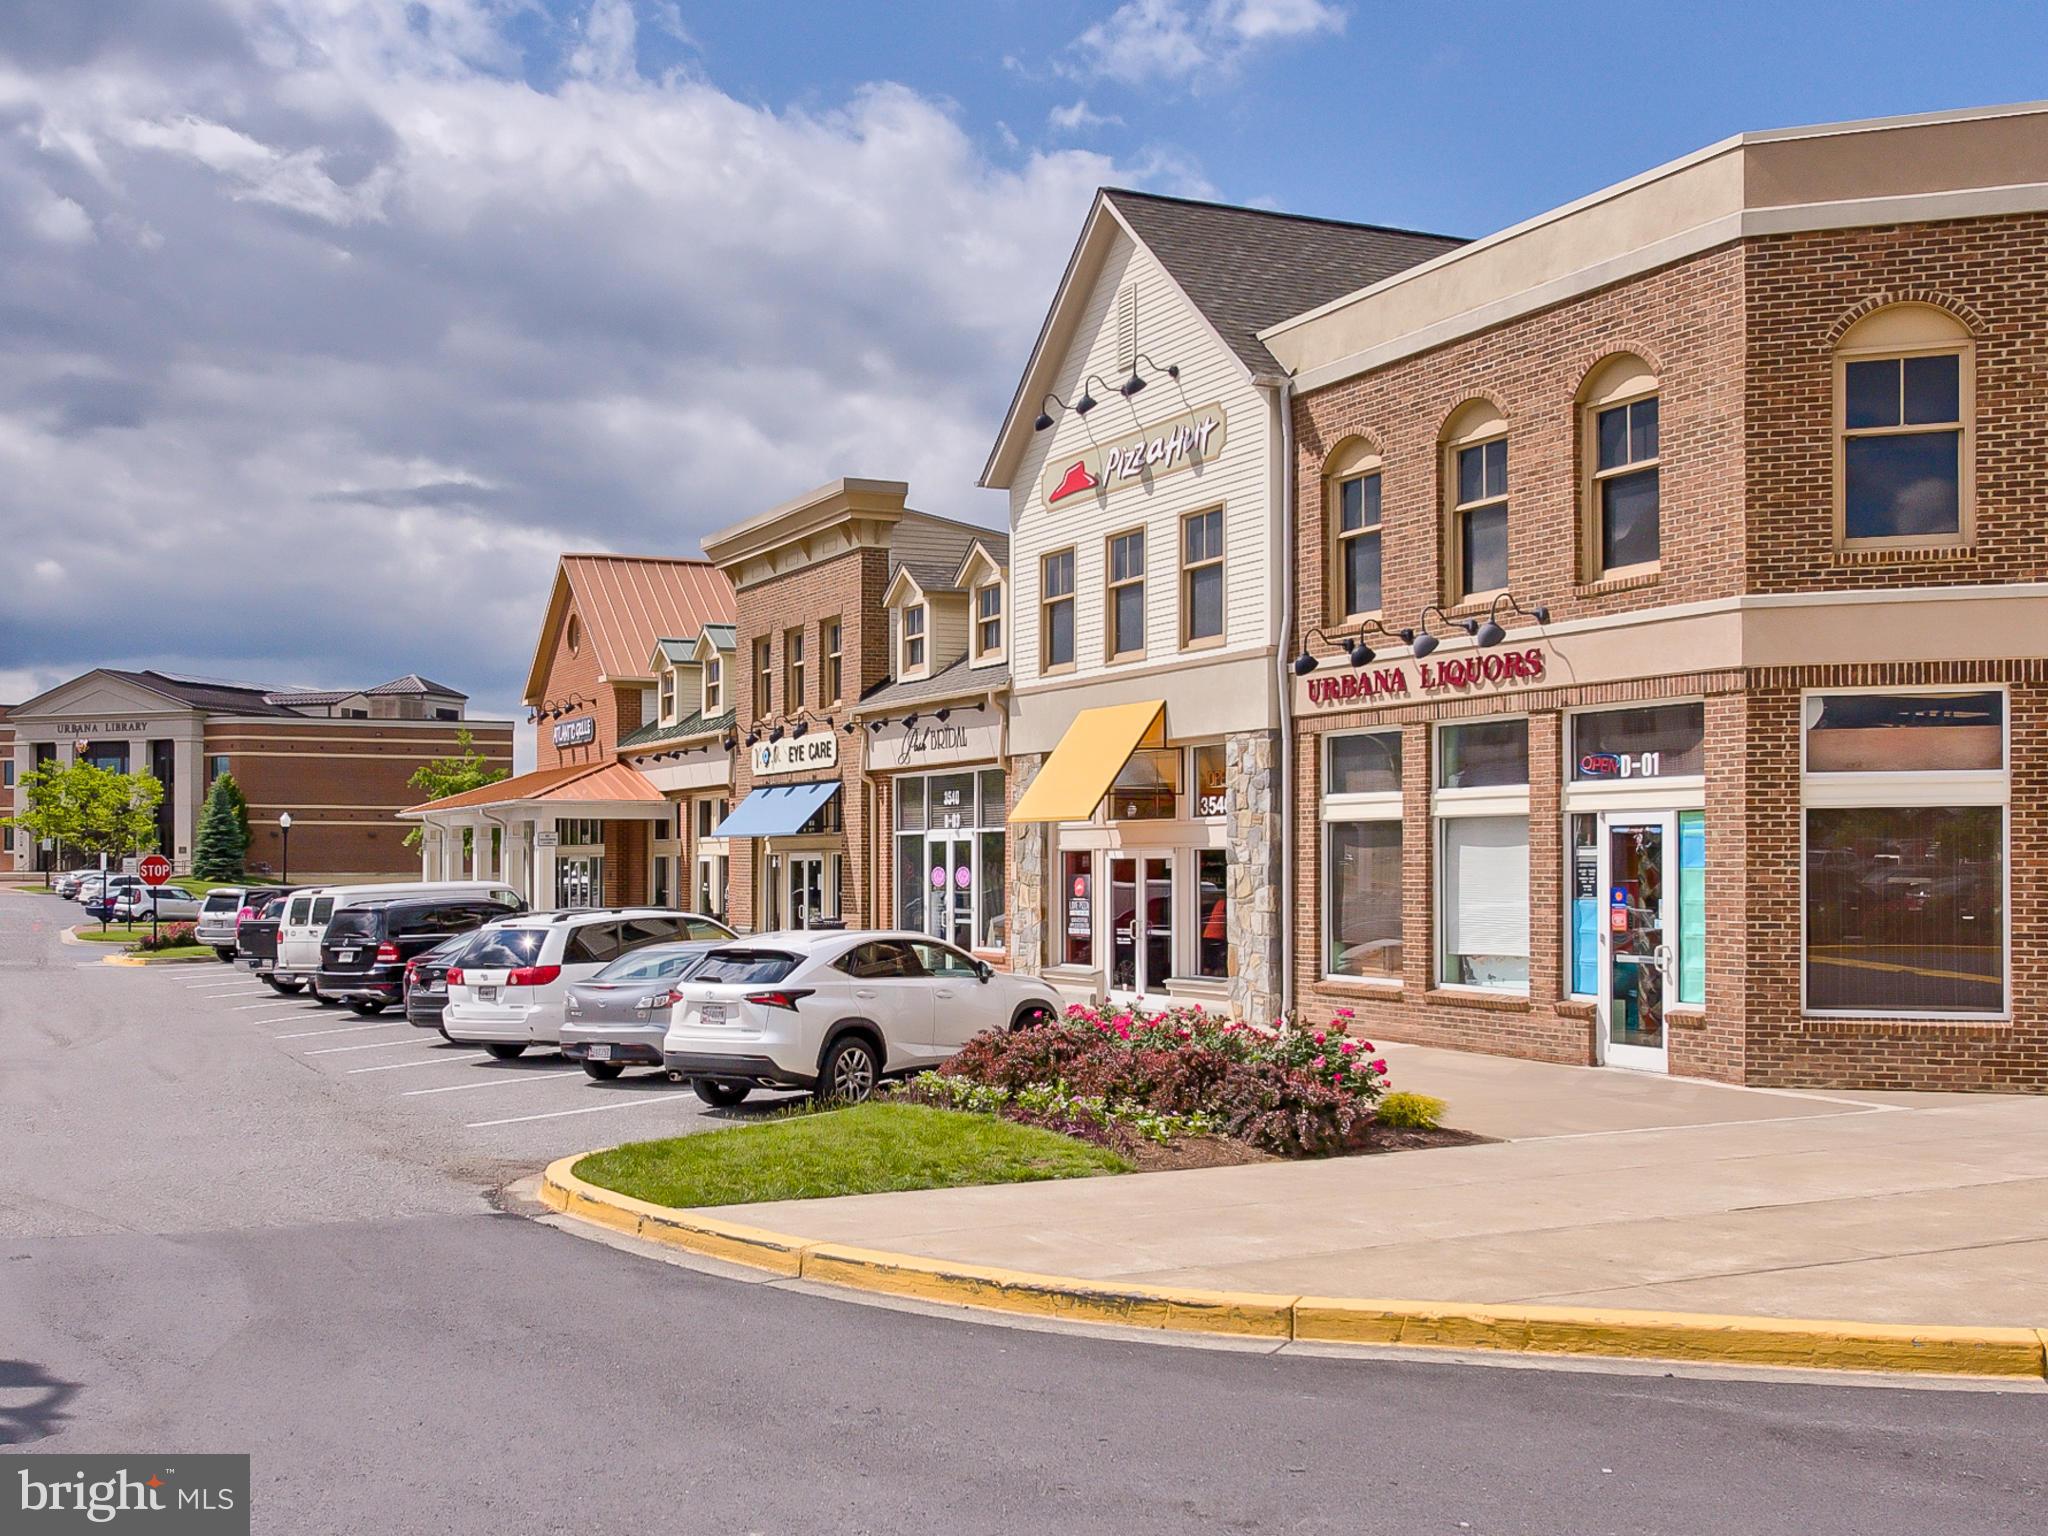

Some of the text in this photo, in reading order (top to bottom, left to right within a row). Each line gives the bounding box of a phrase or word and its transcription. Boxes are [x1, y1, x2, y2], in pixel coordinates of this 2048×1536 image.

[1104, 416, 1220, 489] Pizza Hut
[1307, 648, 1543, 702] URBANA LIQUORS
[57, 722, 147, 733] URBANA LIBRARY
[930, 726, 968, 750] BRIDAL
[788, 745, 805, 763] EYE
[808, 740, 832, 760] CARE
[1581, 752, 1660, 778] OPEN D-01
[141, 864, 170, 877] STOP
